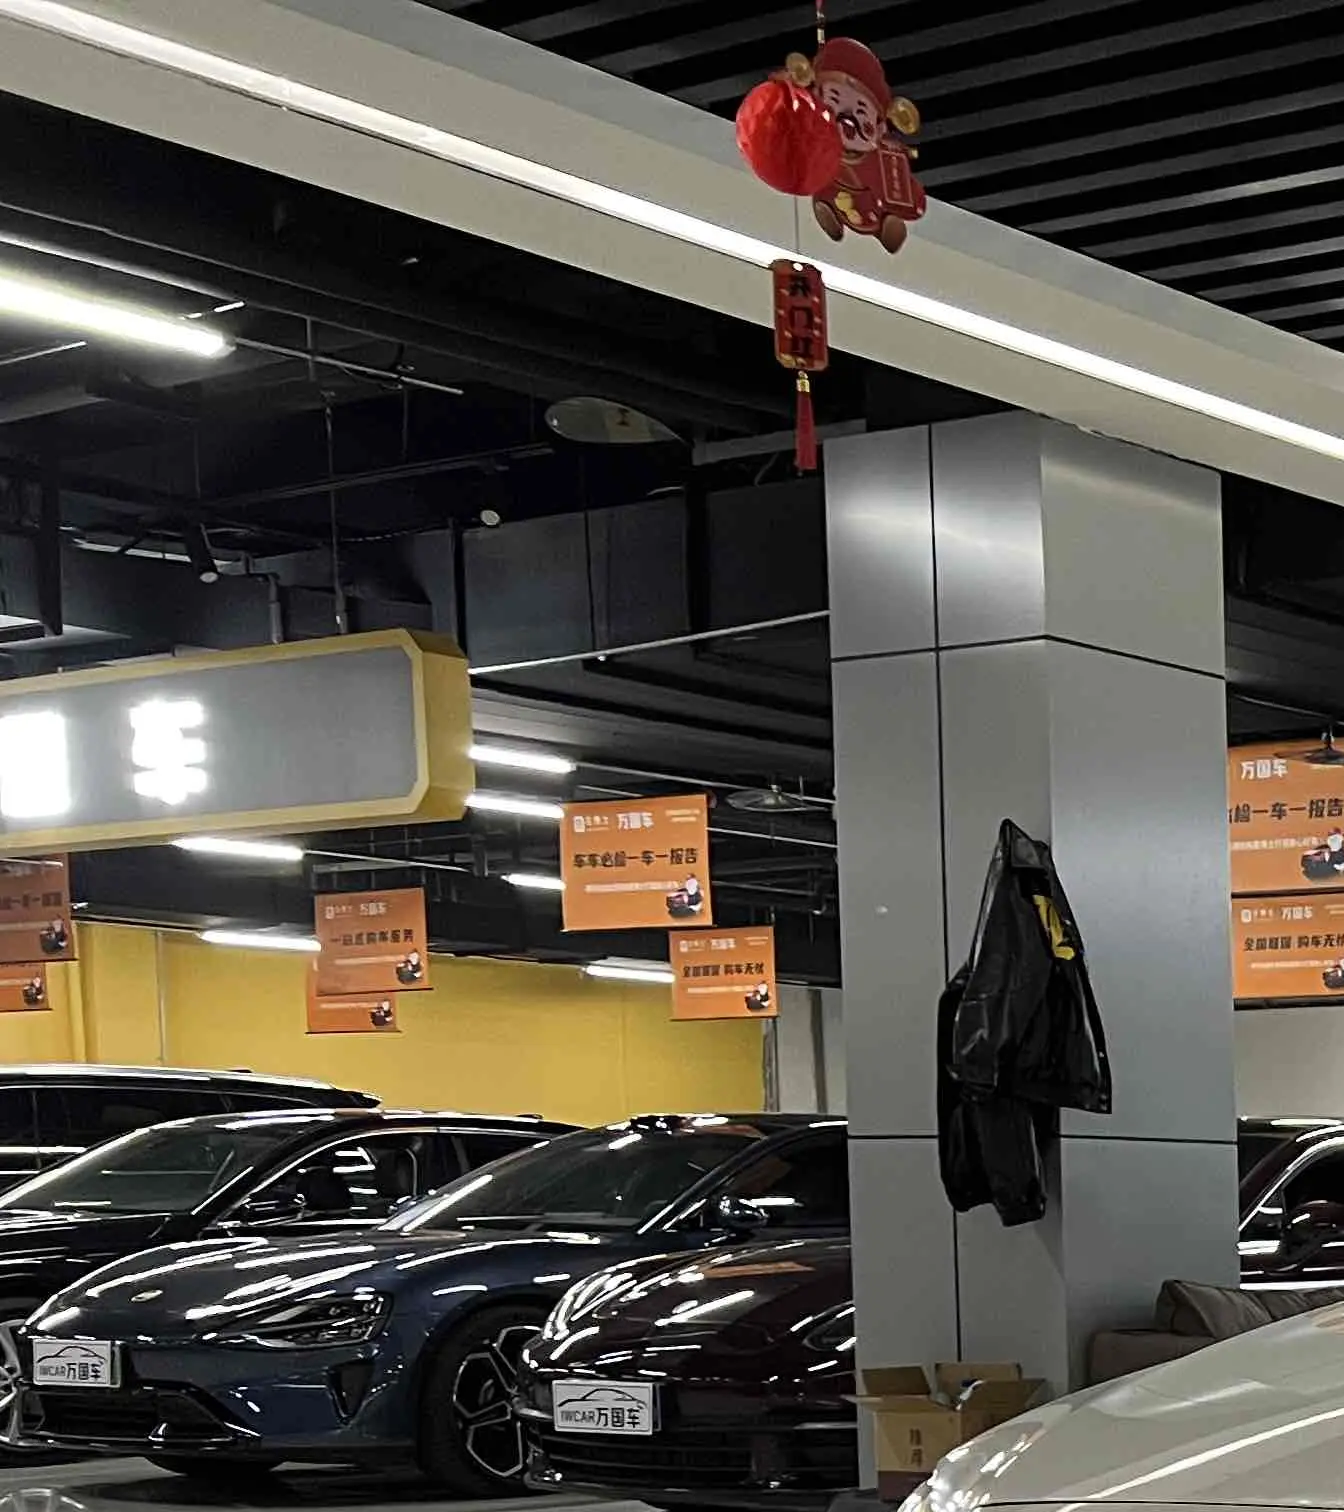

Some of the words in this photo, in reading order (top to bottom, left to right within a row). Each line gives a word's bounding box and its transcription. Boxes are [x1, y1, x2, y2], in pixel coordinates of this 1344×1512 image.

[1240, 759, 1289, 780] 万国车
[1229, 798, 1344, 825] 检一车一报告
